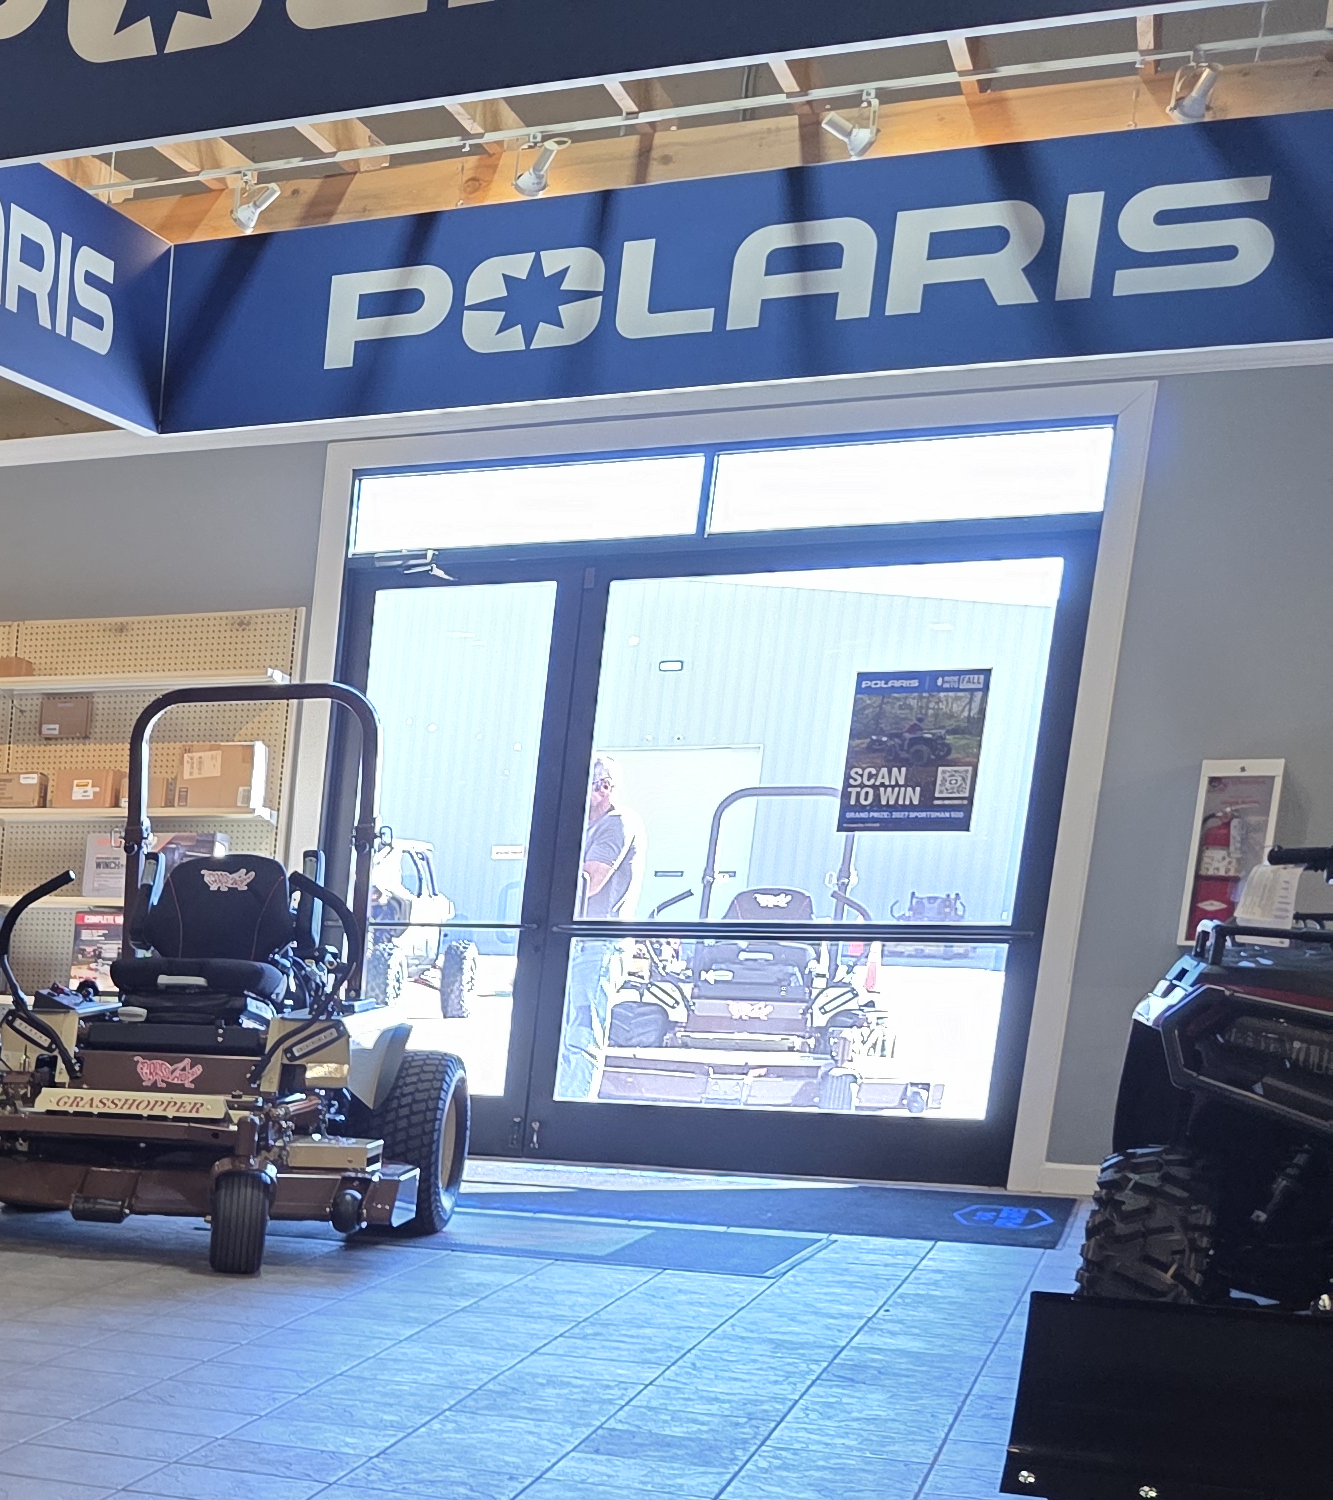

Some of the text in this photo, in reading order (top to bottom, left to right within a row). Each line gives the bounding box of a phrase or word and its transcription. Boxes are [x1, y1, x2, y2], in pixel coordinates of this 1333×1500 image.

[323, 174, 1276, 370] POLARIS
[861, 679, 920, 689] POLARIS
[960, 675, 982, 686] FALL
[848, 766, 907, 786] SCAN
[847, 786, 921, 806] TO WIN
[54, 1094, 206, 1115] GRASSHOPPER
